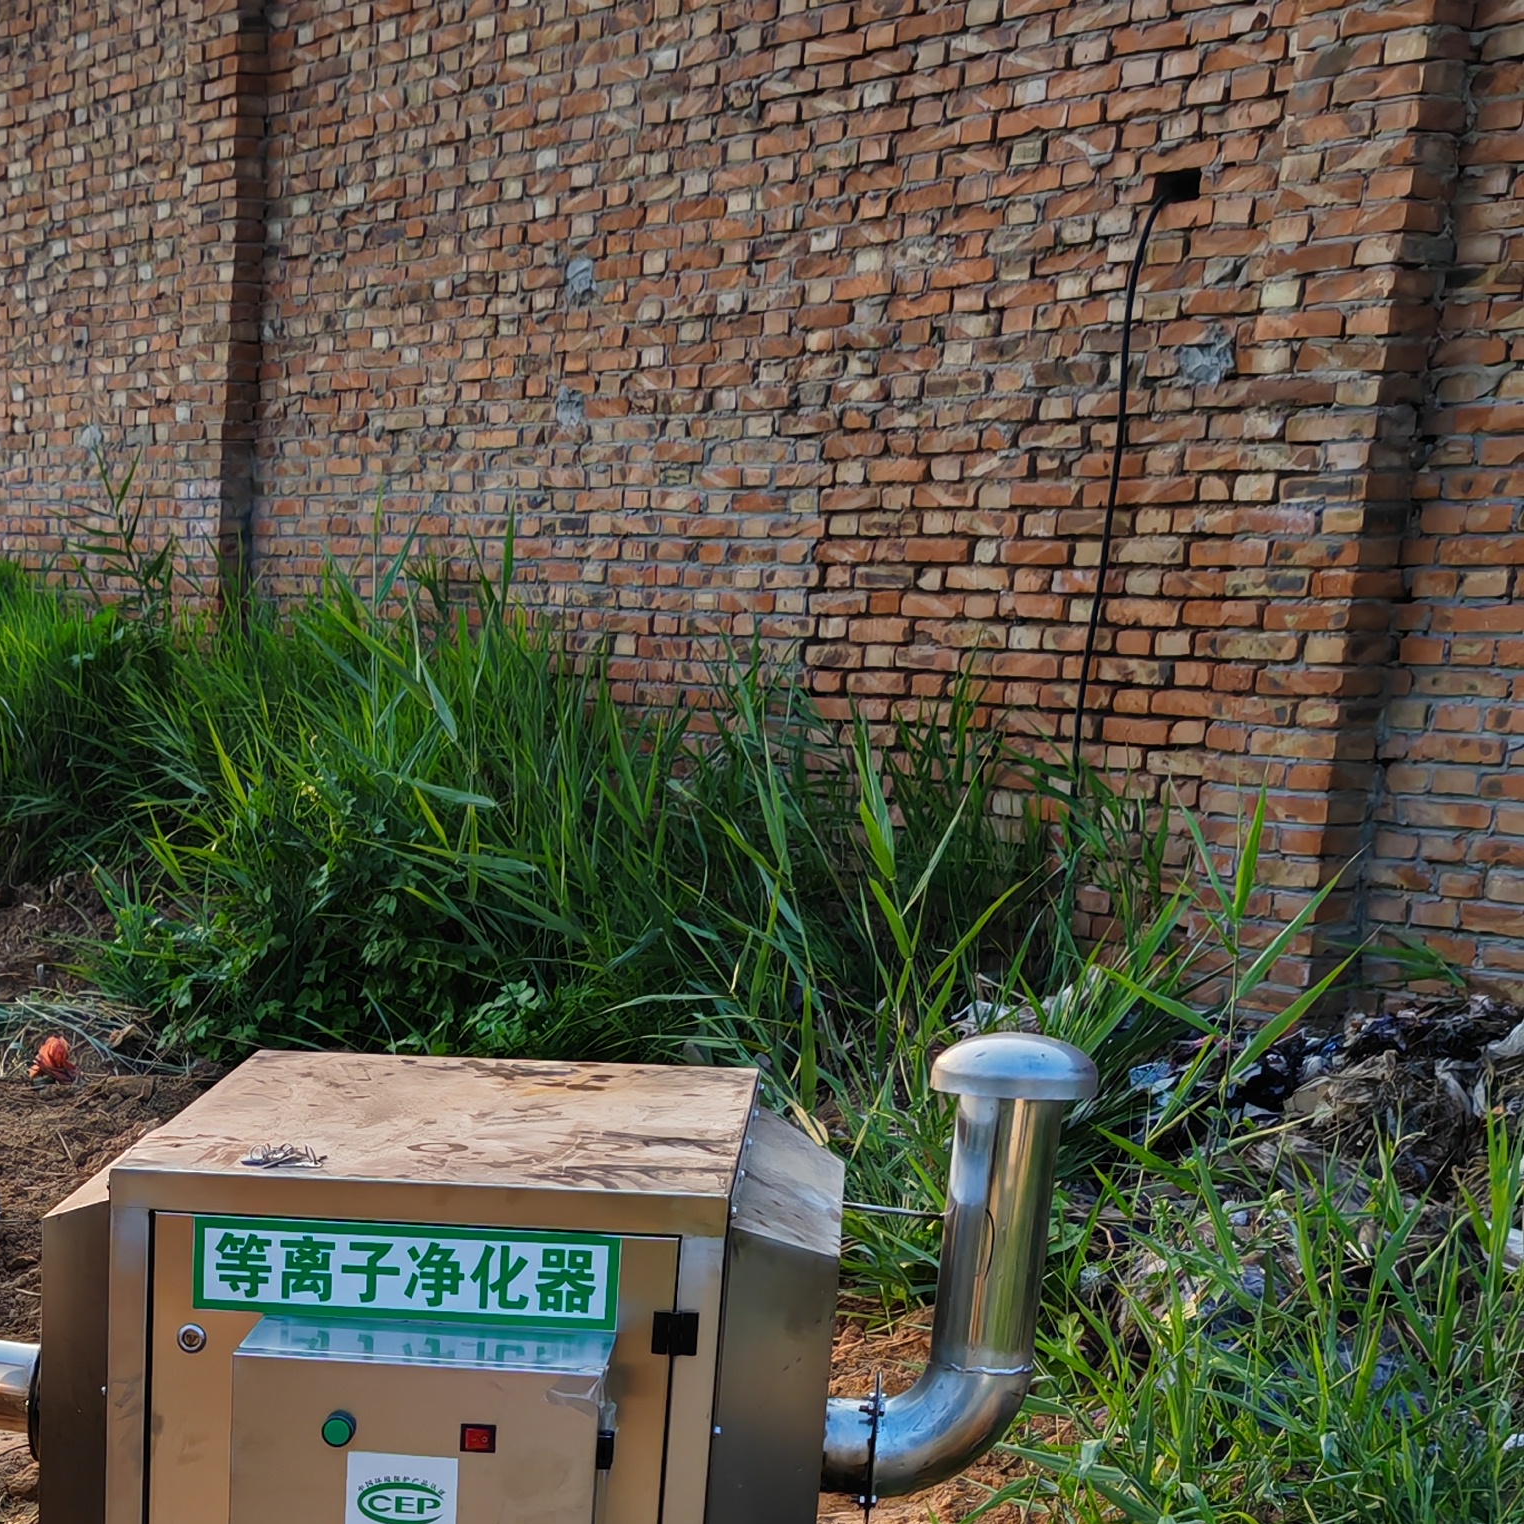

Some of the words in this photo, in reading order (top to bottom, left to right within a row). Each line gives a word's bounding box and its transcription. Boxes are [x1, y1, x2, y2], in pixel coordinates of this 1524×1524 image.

[214, 1231, 597, 1314] 等离子净化器
[368, 1495, 441, 1515] CEP
